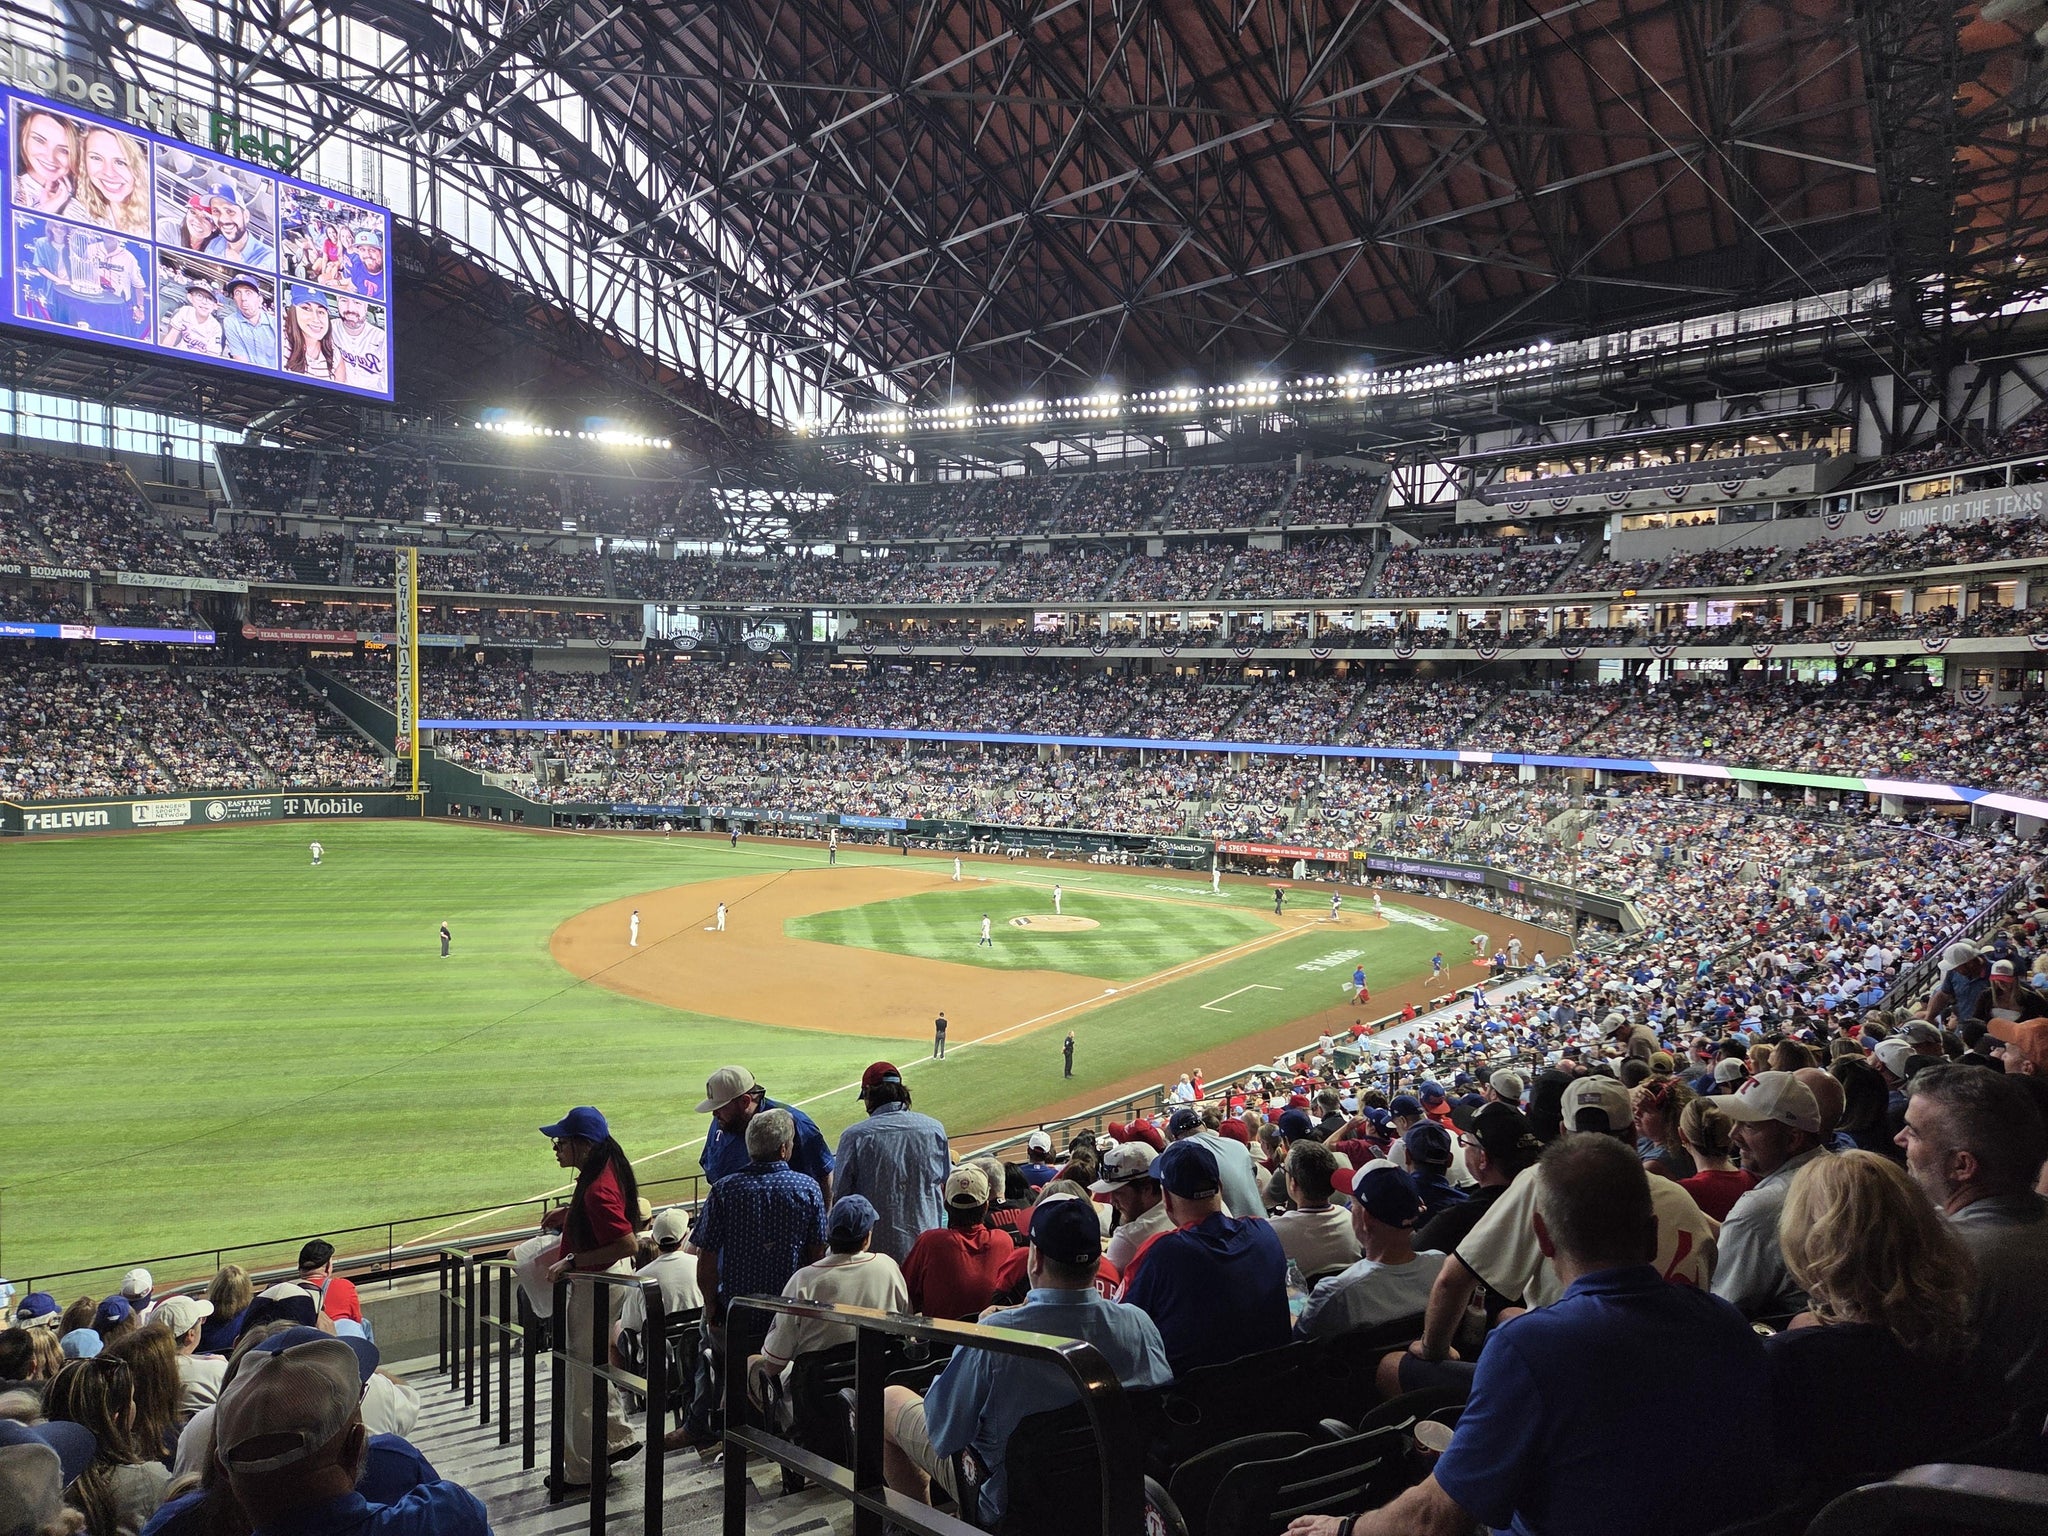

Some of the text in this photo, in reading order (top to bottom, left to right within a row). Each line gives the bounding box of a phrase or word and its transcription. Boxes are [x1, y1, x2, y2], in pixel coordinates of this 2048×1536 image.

[125, 81, 200, 137] Life
[210, 111, 293, 169] Field
[1900, 491, 2043, 527] HOME OF THE TEXAS
[30, 565, 91, 579] BODYARMOR
[120, 572, 148, 585] Blue
[152, 576, 184, 588] Mint
[398, 575, 409, 646] CHIKIN
[5, 626, 35, 634] Rangers
[260, 631, 279, 639] TEXAS,
[400, 683, 410, 731] FARE
[227, 800, 245, 808] EAST
[239, 806, 260, 814] A&M
[303, 798, 363, 815] Mobile
[227, 811, 271, 819] UNIVERSITY
[731, 809, 754, 817] American
[788, 813, 812, 821] American
[1167, 842, 1206, 854] Medical City
[1228, 845, 1248, 853] SPEC'S
[1326, 851, 1347, 860] SPEC'S
[715, 1129, 724, 1142] T
